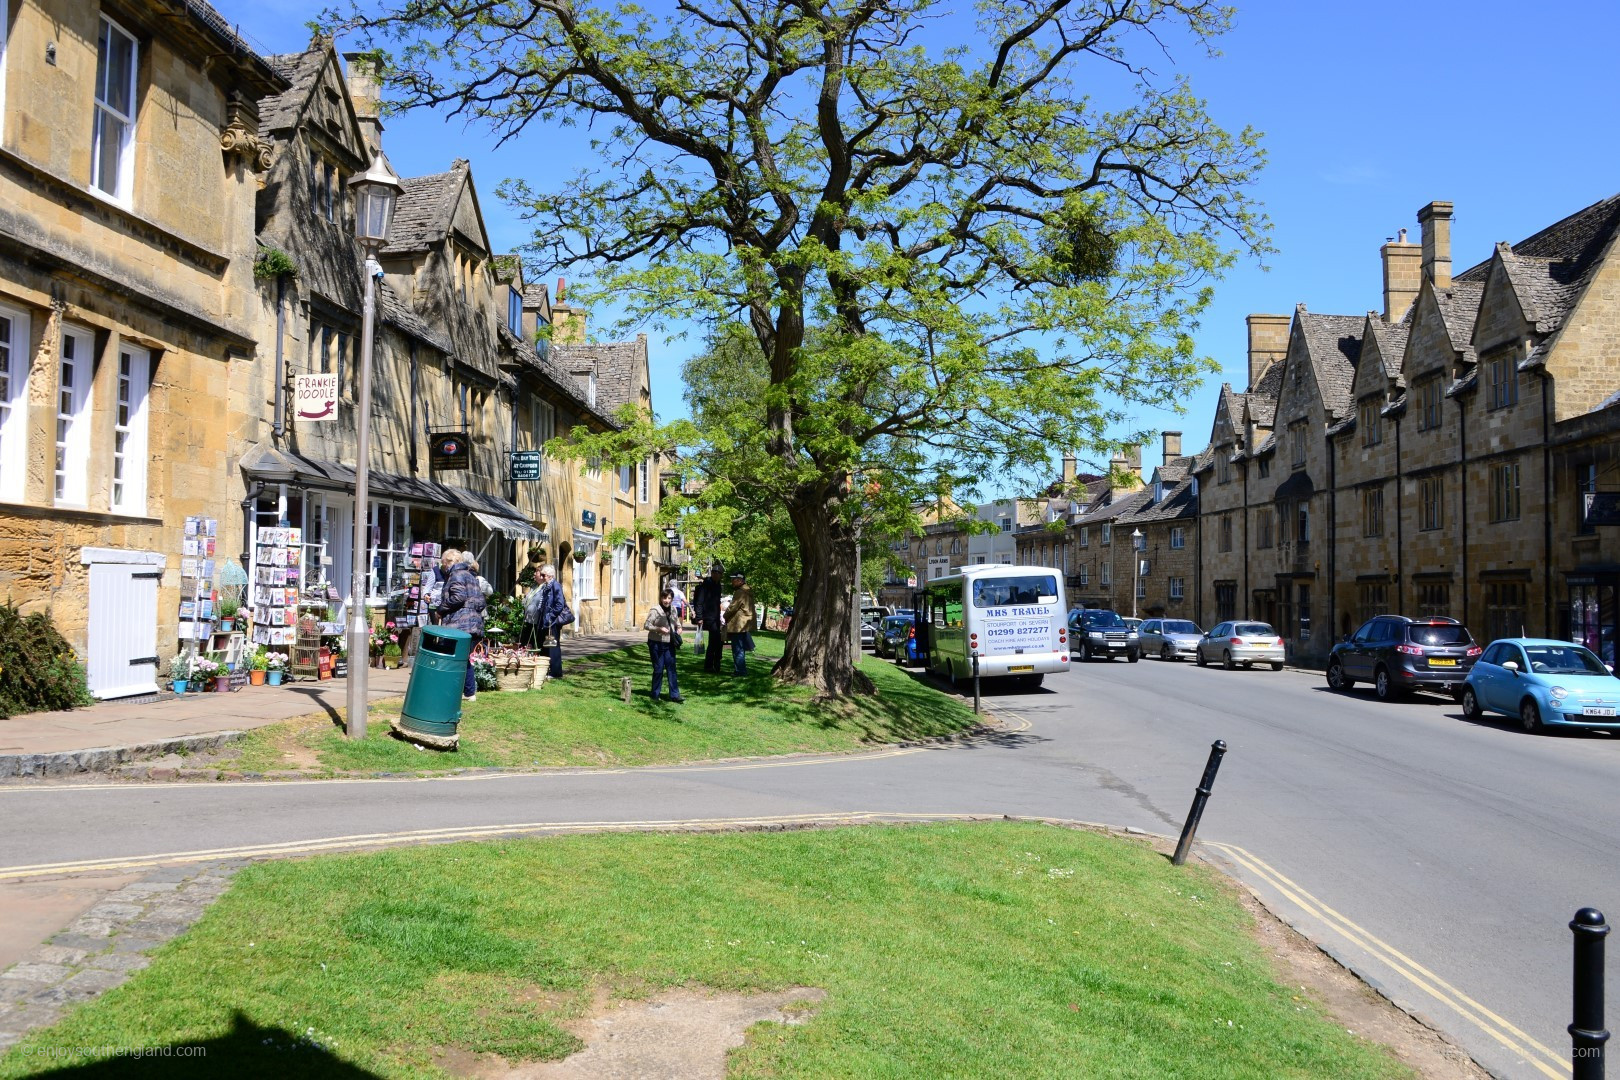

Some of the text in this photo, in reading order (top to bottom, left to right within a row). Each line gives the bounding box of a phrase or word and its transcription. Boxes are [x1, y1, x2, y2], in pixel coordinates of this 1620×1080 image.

[297, 377, 336, 389] FRANKIE
[298, 389, 335, 399] DOODLE
[986, 607, 1050, 617] MHS TRAVEL
[987, 626, 1049, 636] 01299 827277
